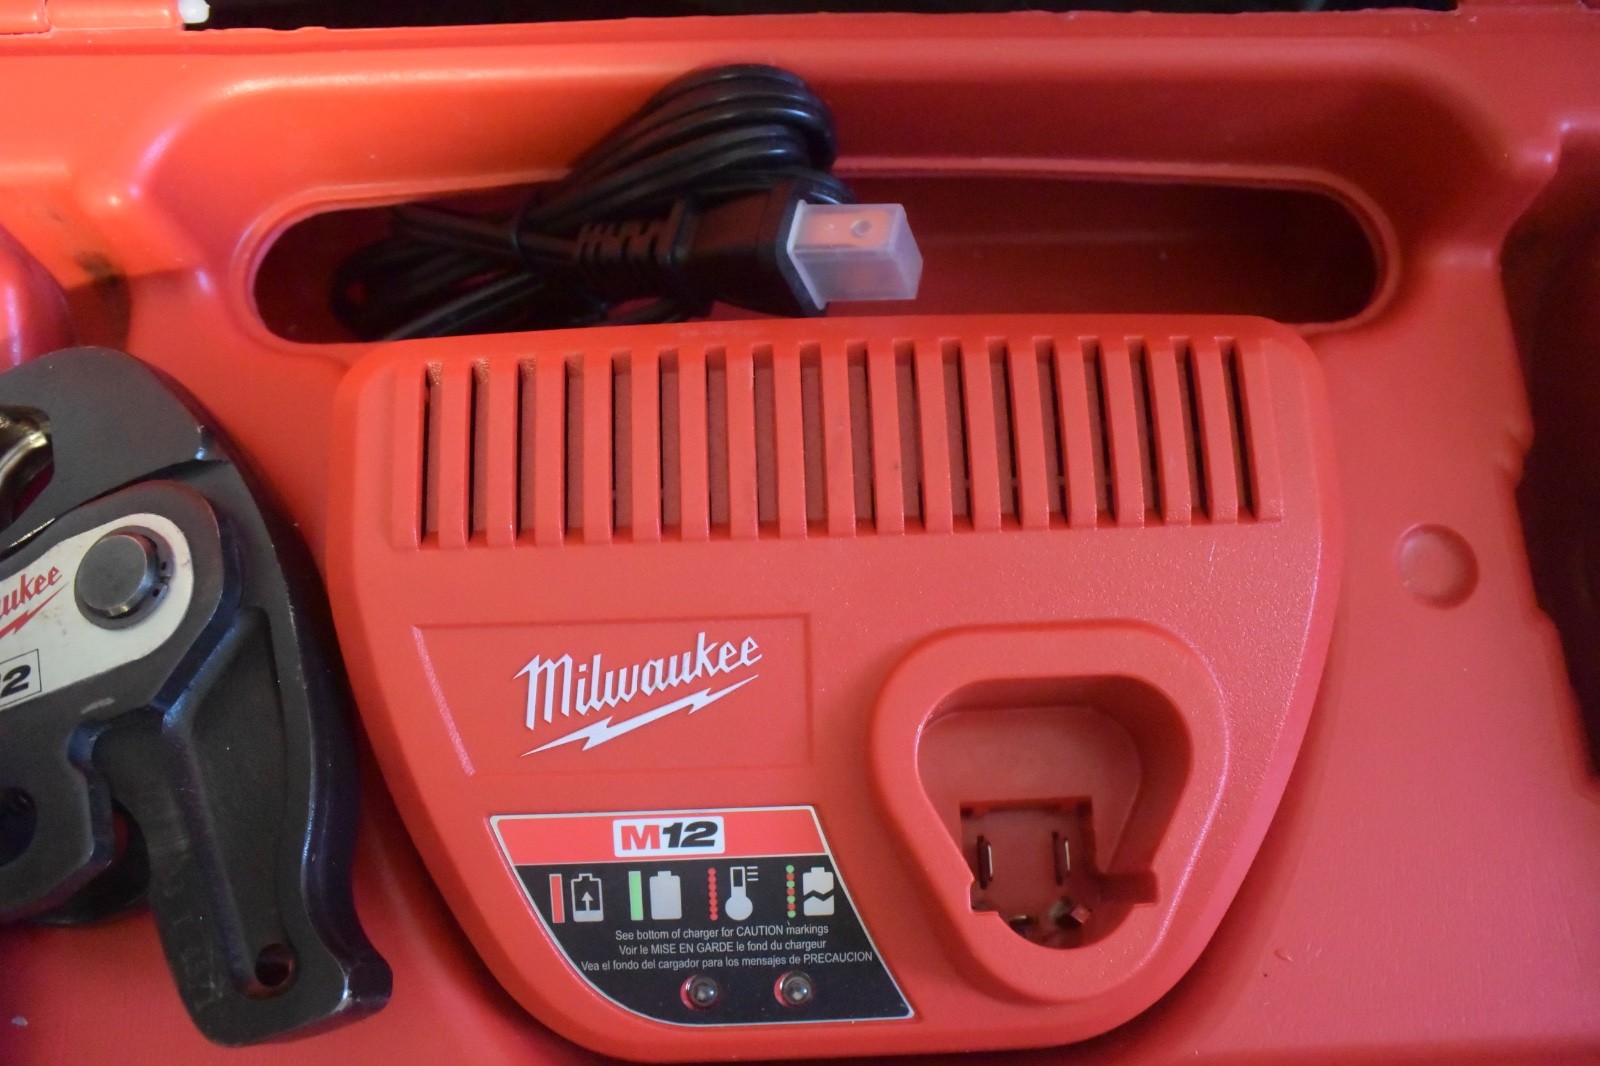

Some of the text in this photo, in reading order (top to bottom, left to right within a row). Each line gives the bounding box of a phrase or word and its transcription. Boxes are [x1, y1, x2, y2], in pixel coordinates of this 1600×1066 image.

[0, 566, 62, 619] ukee
[512, 631, 763, 731] Milwaukee
[620, 820, 719, 851] M12
[615, 924, 829, 941] See bottom of charger for CAUTION markings
[619, 939, 827, 956] Voir le MISE EN GARDE le fond du chargeur
[581, 951, 873, 971] Vea el fondo del cargador para los mensajes de PRECAUCION
